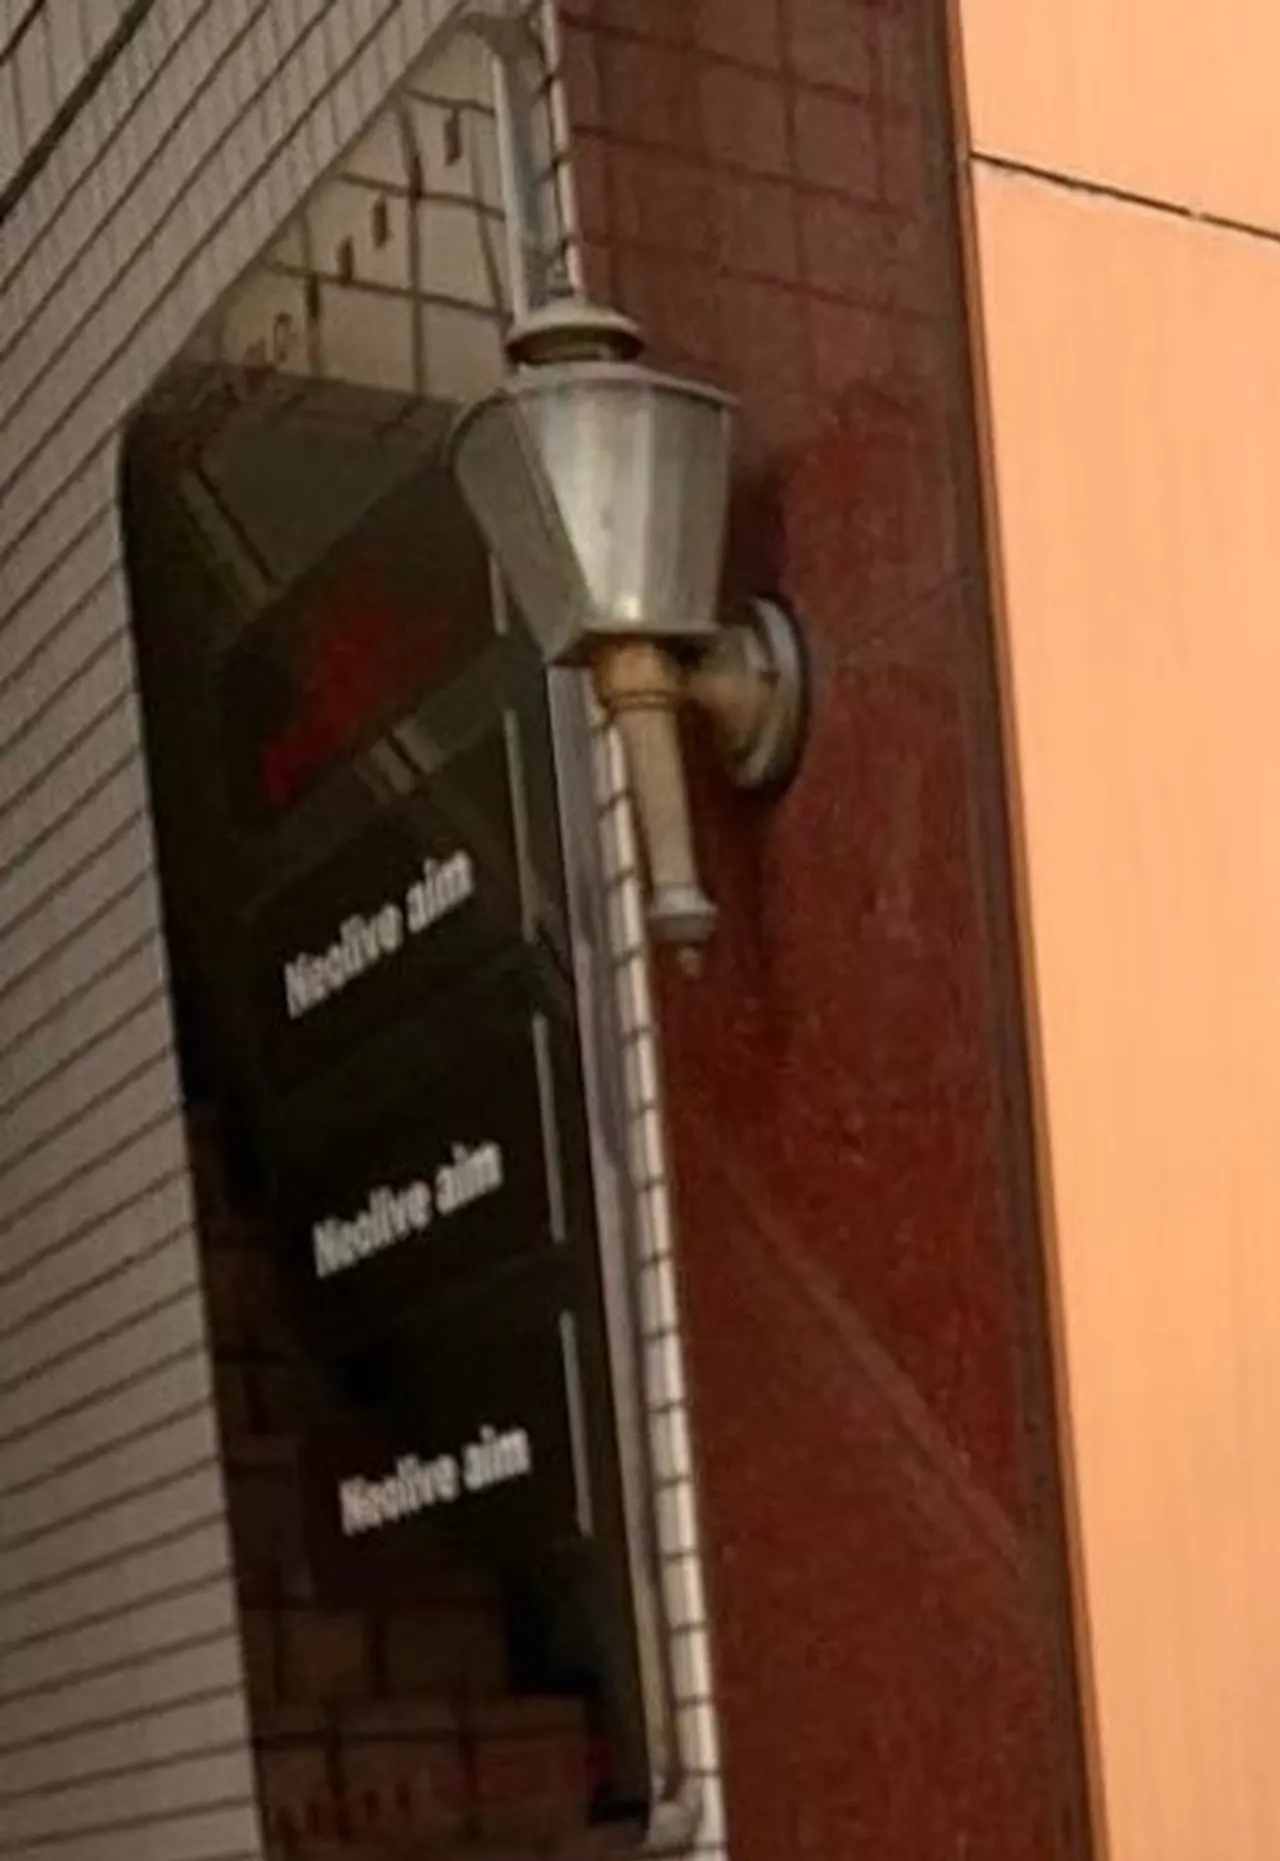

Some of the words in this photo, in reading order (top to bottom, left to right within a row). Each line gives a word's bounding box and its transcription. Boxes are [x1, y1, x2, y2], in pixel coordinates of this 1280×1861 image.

[285, 902, 404, 1020] Neolive
[406, 849, 475, 934] aim
[312, 1180, 432, 1279] Neolive
[435, 1141, 504, 1216] aim
[339, 1453, 460, 1537] Neolive
[463, 1424, 533, 1490] aim
